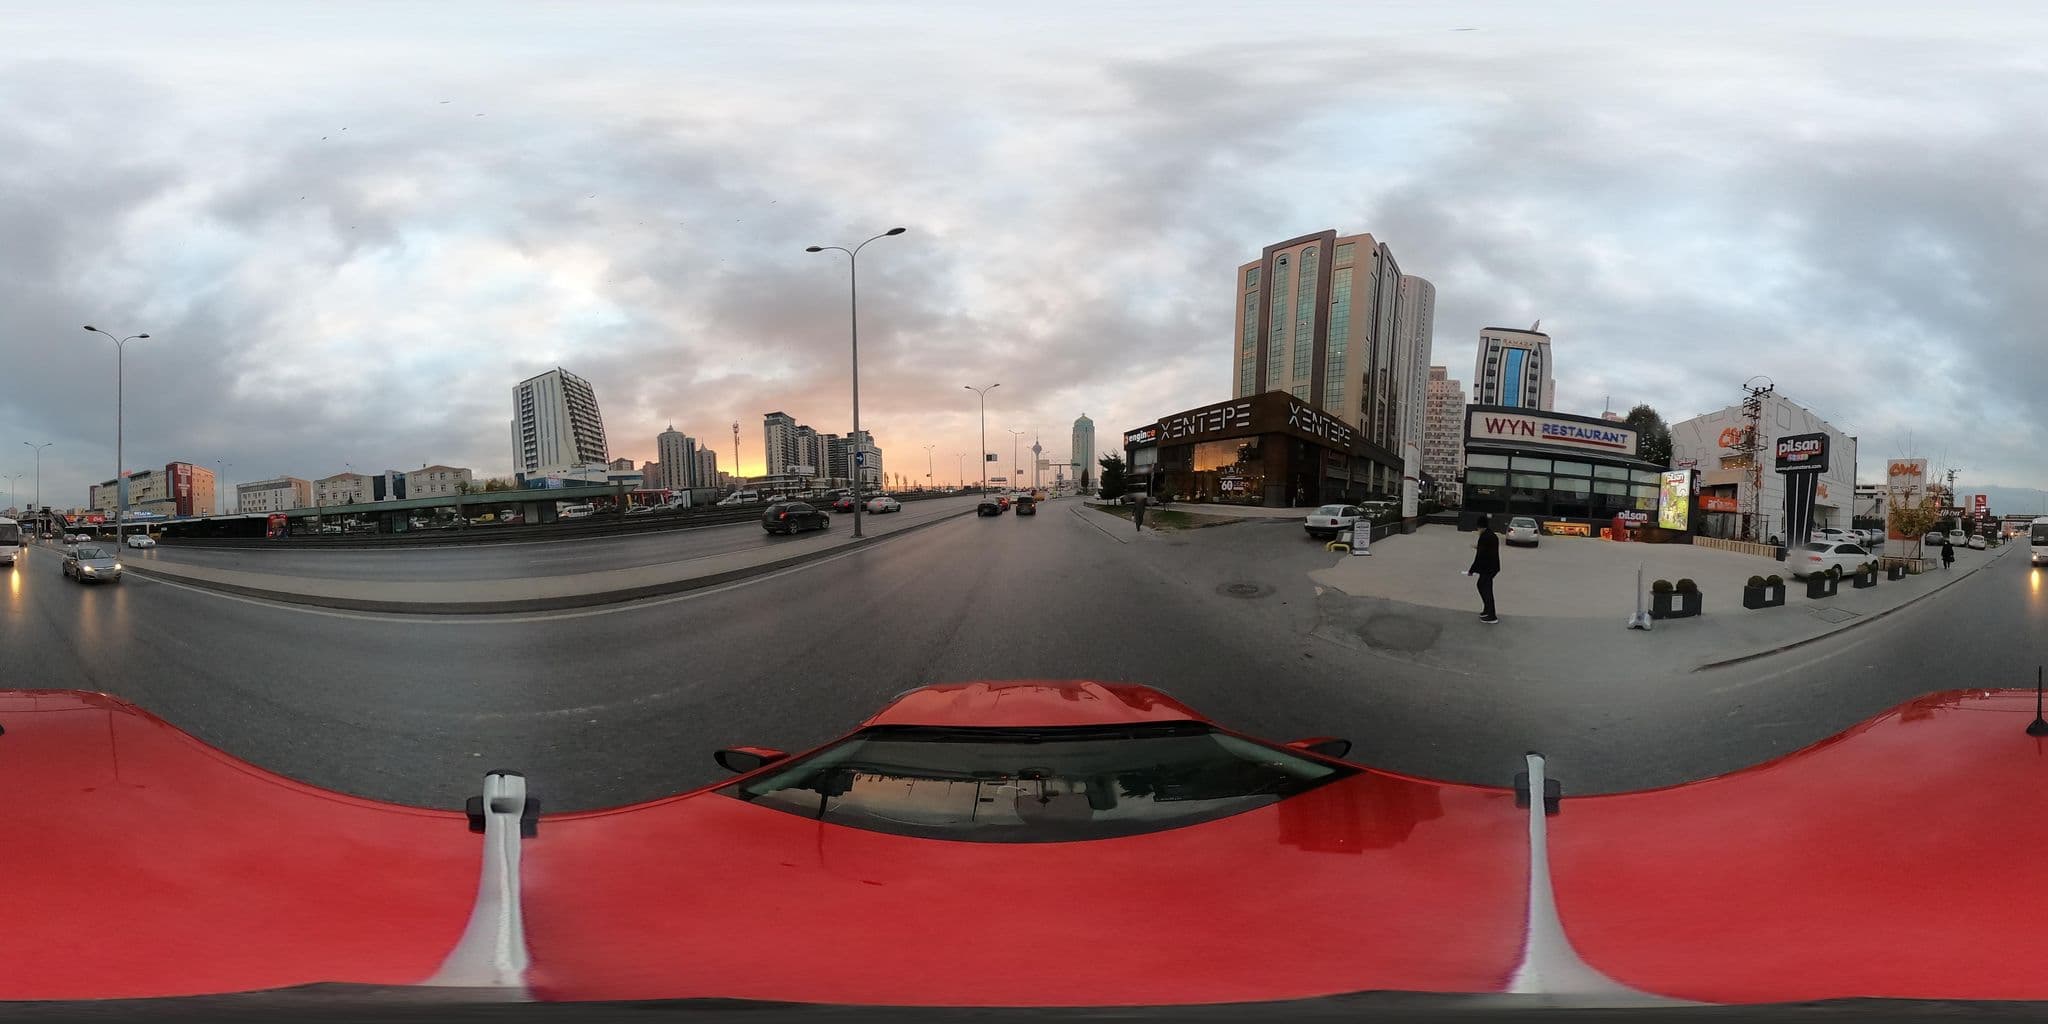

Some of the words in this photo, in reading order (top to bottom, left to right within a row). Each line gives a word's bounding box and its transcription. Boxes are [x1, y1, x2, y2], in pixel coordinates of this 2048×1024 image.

[1161, 403, 1250, 441] XENTEPE
[1289, 402, 1351, 447] XENTEPE
[1485, 417, 1536, 437] WYN
[1541, 423, 1628, 444] RESTAURANT
[1778, 439, 1819, 456] pilsan
